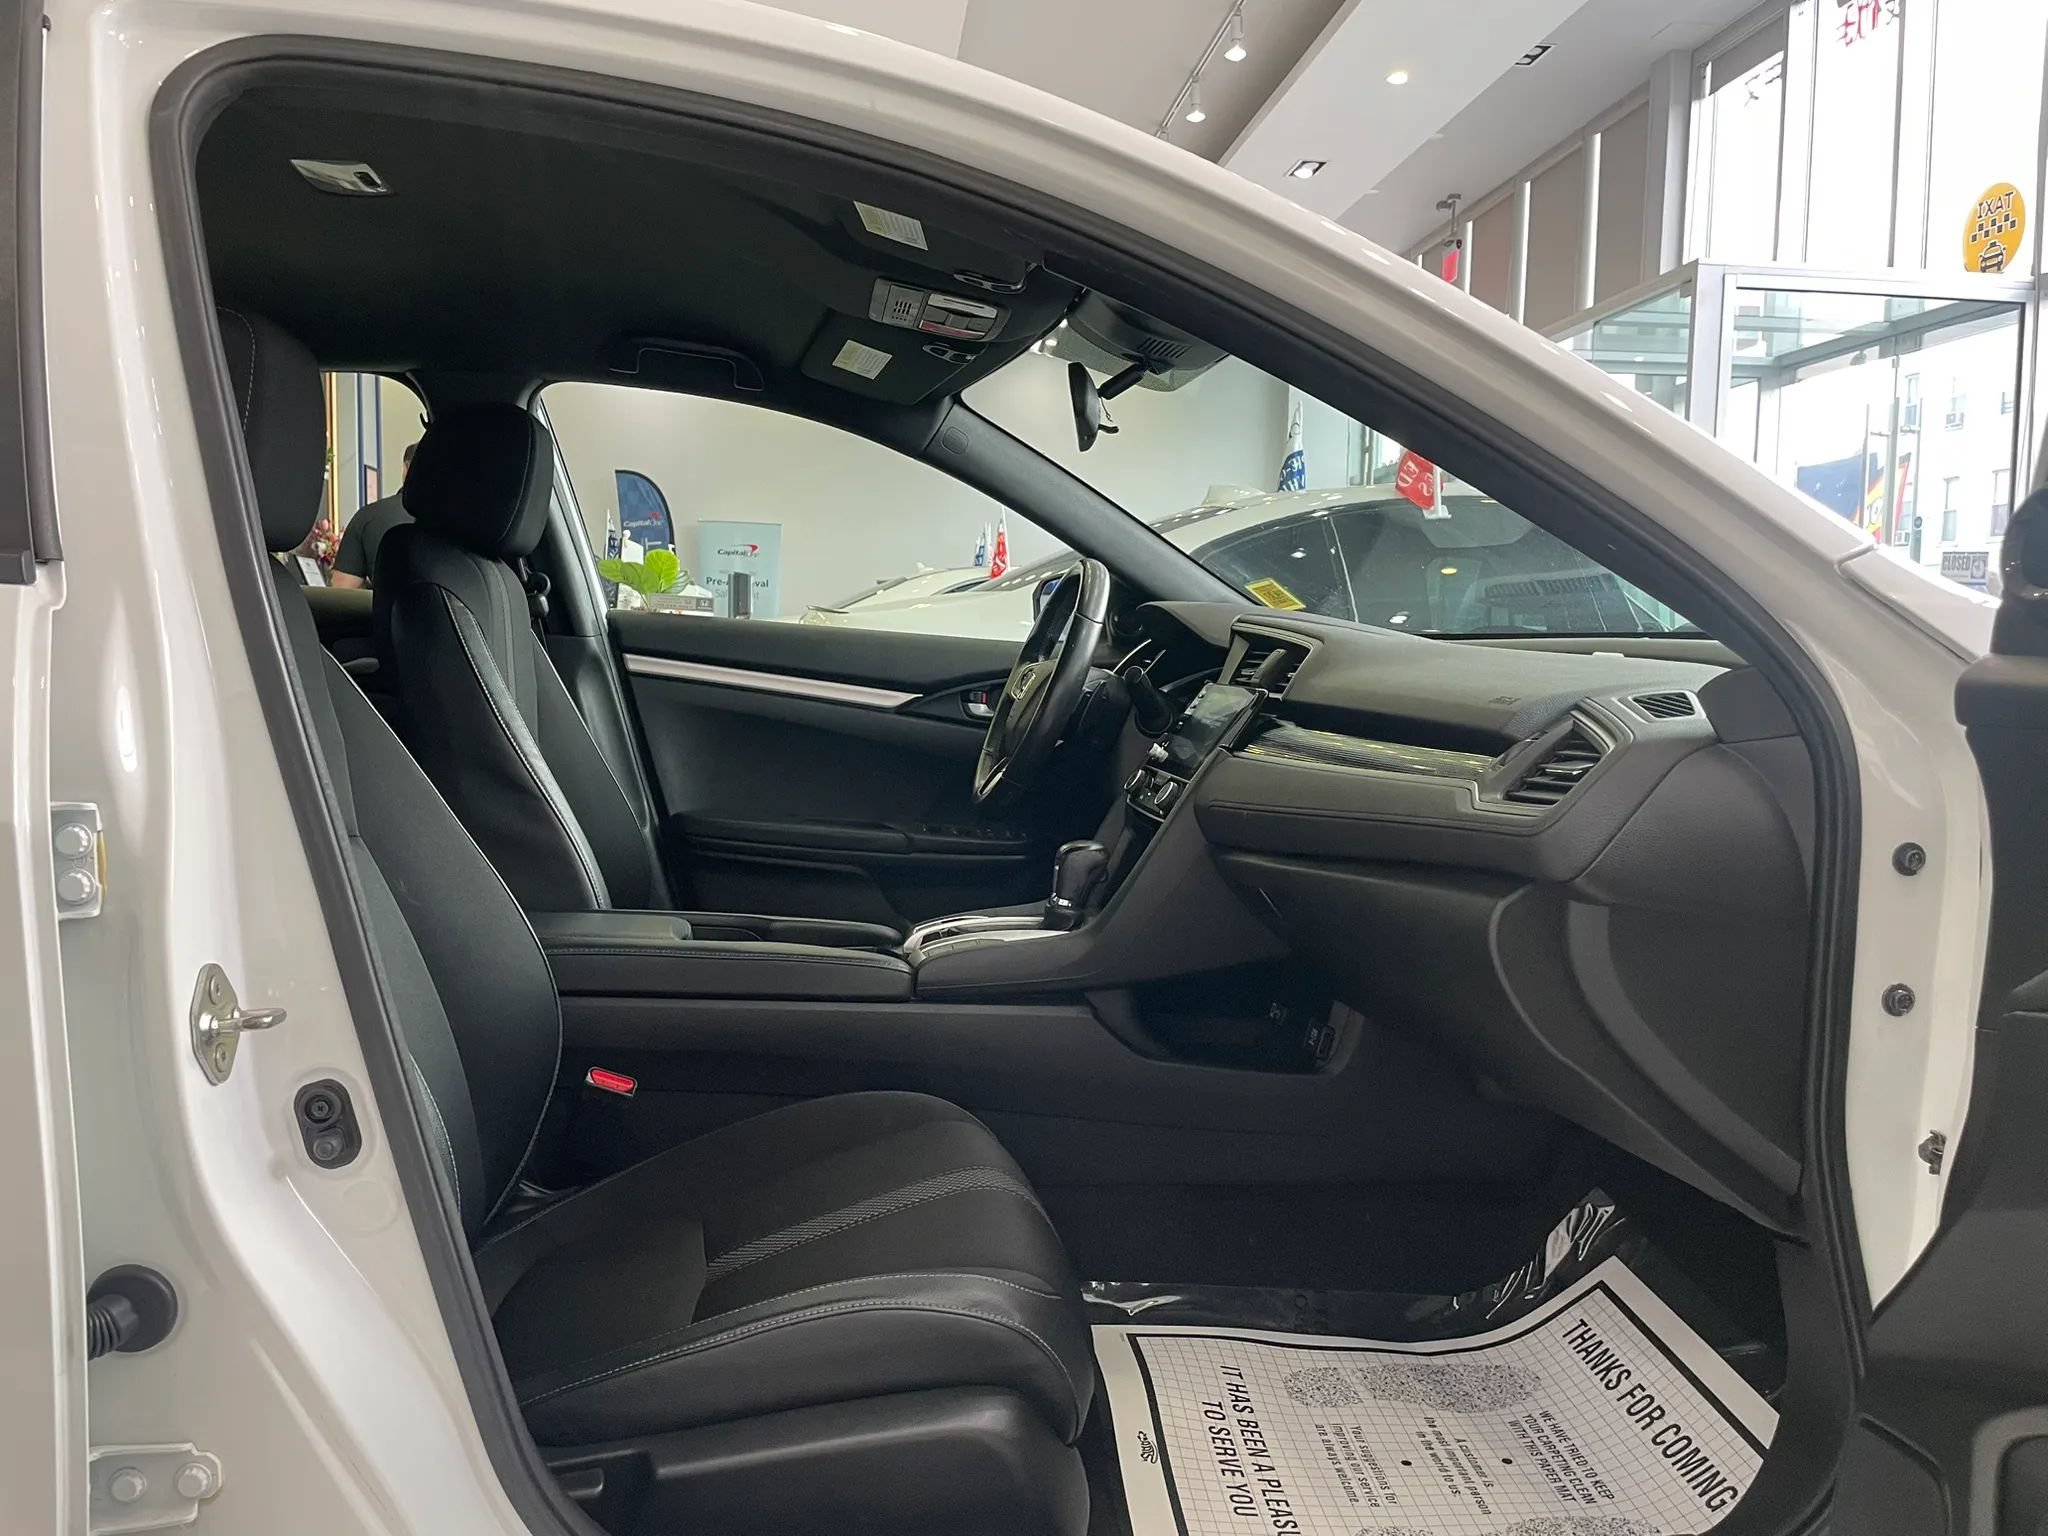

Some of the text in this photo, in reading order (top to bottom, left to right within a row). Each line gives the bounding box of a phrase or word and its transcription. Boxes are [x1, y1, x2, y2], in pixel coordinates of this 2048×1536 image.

[1942, 555, 1971, 571] CLOSED
[1220, 1365, 1244, 1380] IT
[1225, 1382, 1254, 1414] HAS
[1562, 1318, 1739, 1513] THANKS FOR COMING
[1236, 1419, 1271, 1459] BEEN
[1315, 1424, 1328, 1437] are
[1321, 1439, 1341, 1466] always
[1201, 1401, 1259, 1517] TO SERVE YOU
[1251, 1462, 1275, 1473] A
[1349, 1425, 1398, 1505] Your suggestions for
[1420, 1440, 1435, 1451] the
[1429, 1452, 1451, 1473] world
[1442, 1474, 1454, 1483] to
[1423, 1416, 1492, 1515] the most important person
[1458, 1444, 1488, 1479] customer
[1482, 1480, 1494, 1488] is
[1507, 1419, 1577, 1502] WITH THIS PAPER MAT
[1522, 1413, 1598, 1505] YOUR CARPETING CLEAN
[1539, 1410, 1615, 1500] WE HAVE TRIED TO KEEP
[1350, 1462, 1365, 1475] our
[1358, 1477, 1380, 1508] service
